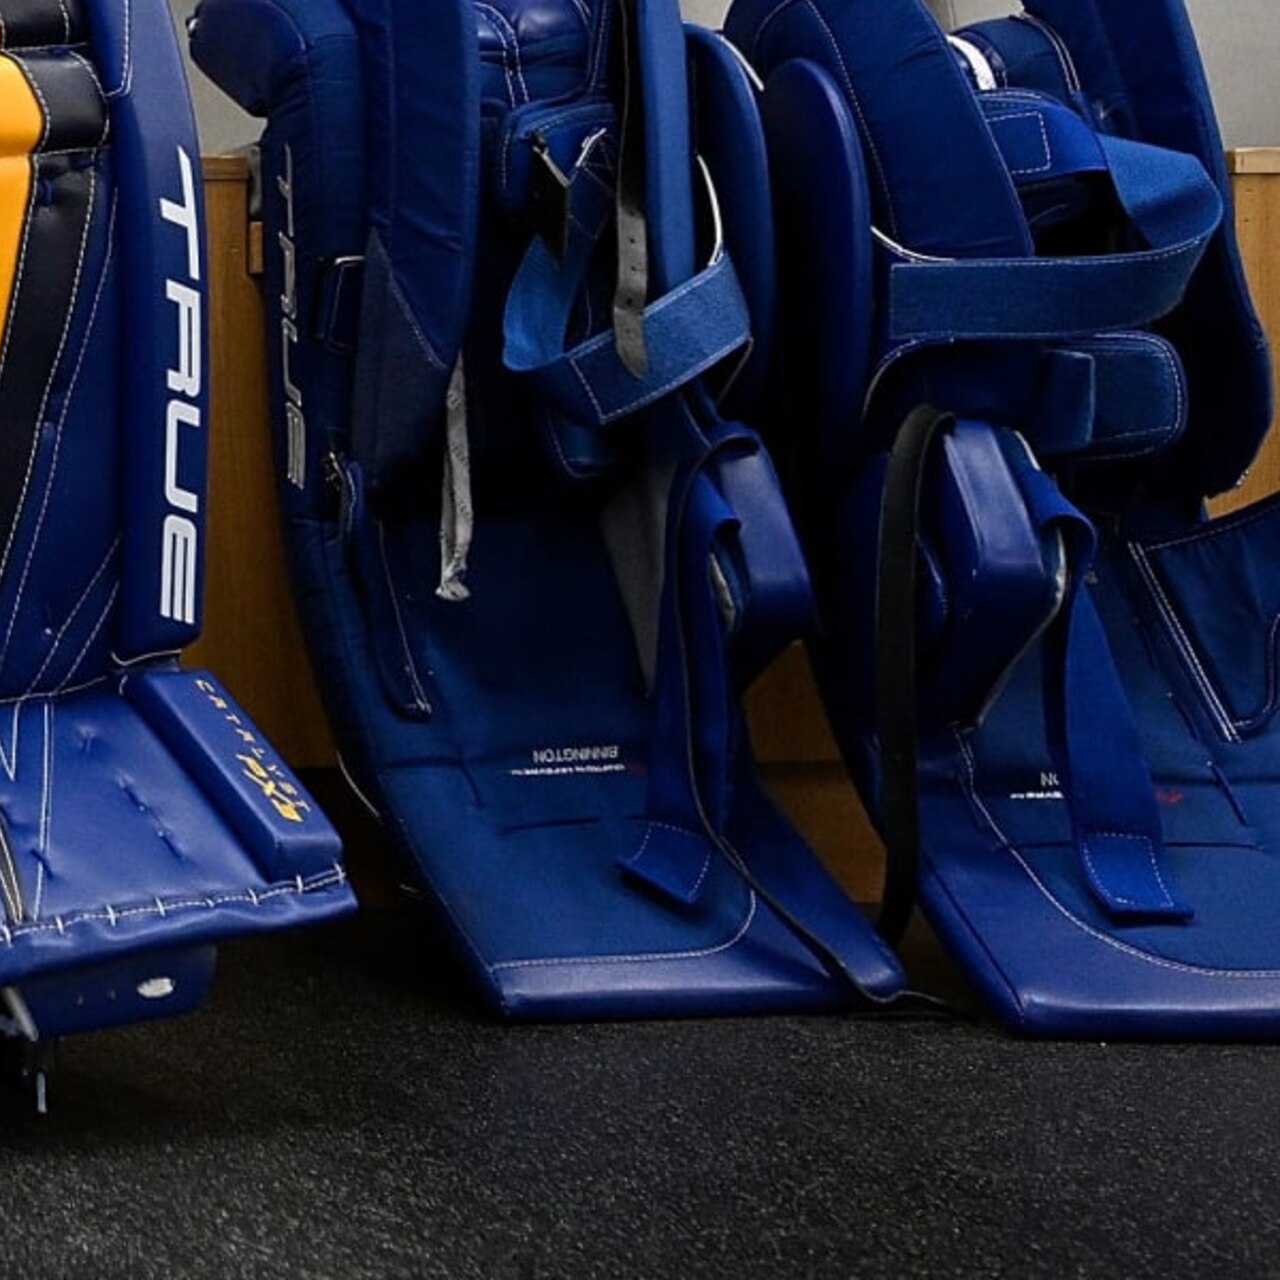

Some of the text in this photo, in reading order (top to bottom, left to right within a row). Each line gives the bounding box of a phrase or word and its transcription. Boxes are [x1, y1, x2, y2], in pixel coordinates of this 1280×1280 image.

[160, 145, 201, 624] TRUE
[277, 142, 307, 490] TRUE
[195, 679, 311, 813] CATALYST
